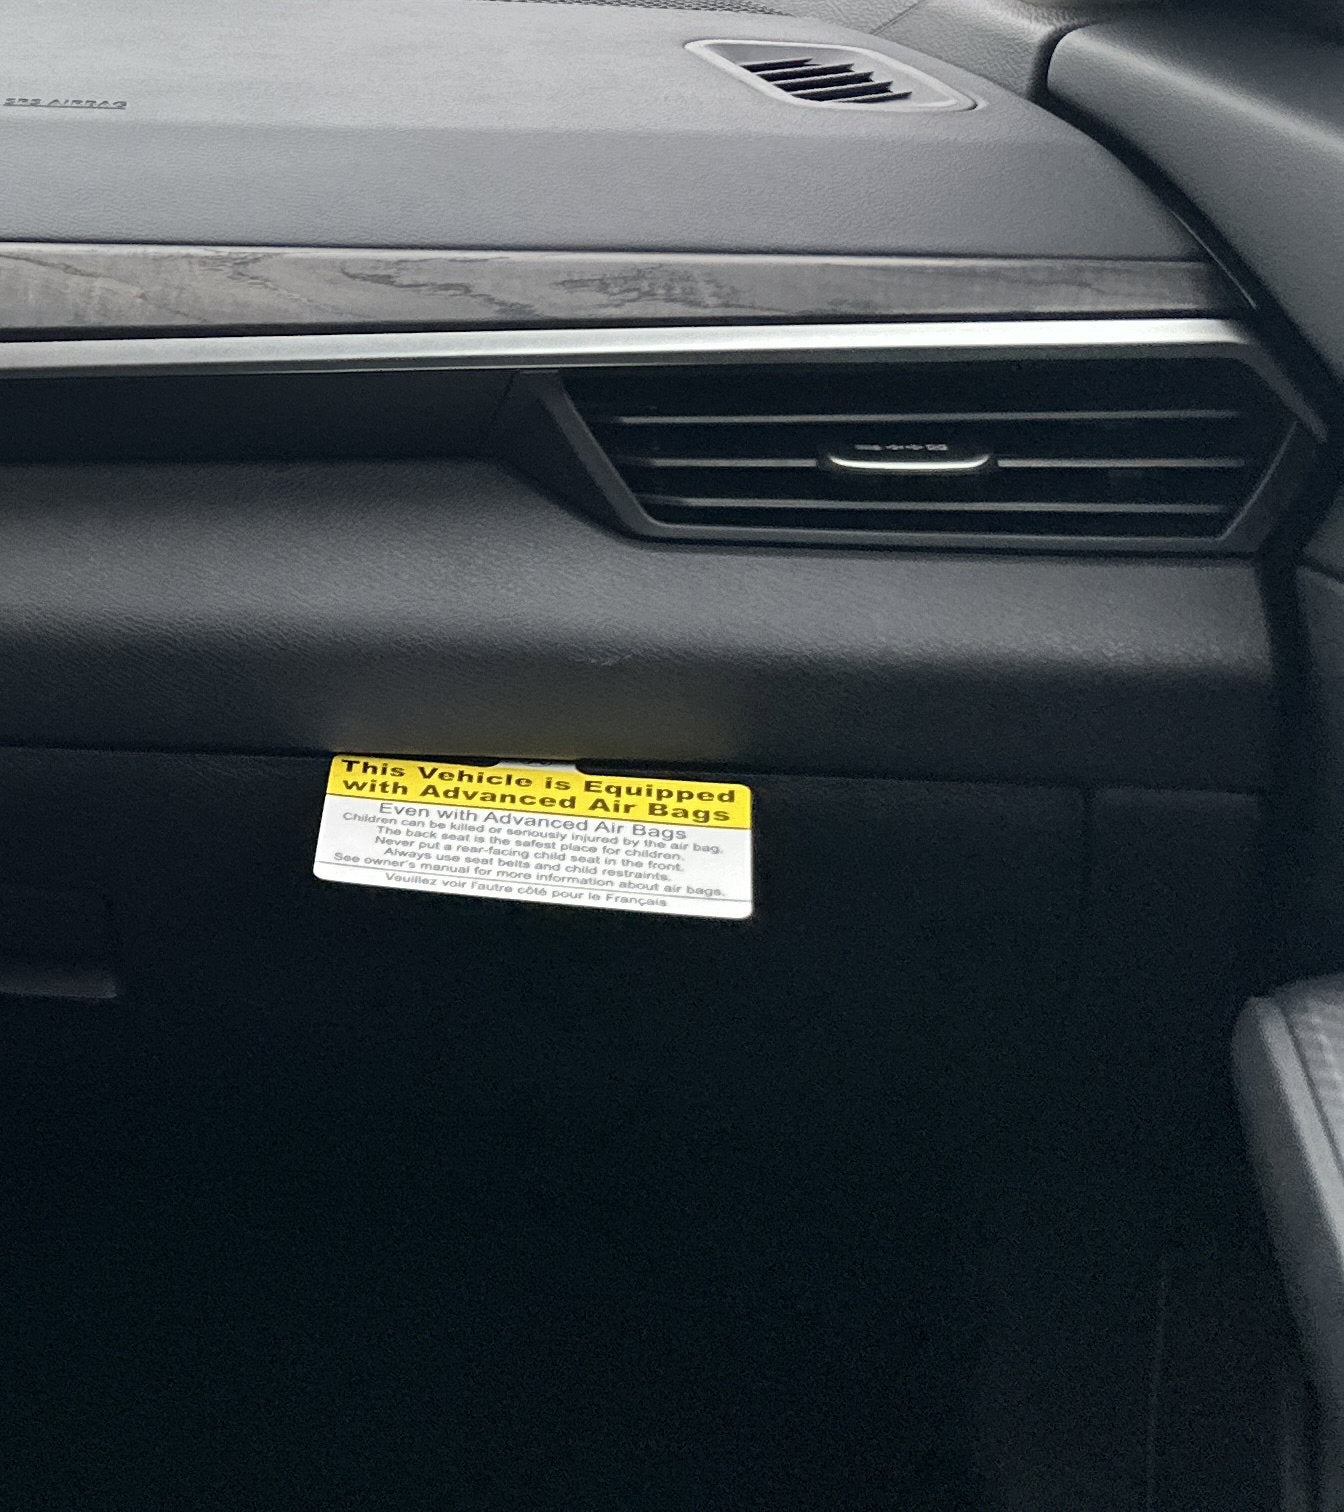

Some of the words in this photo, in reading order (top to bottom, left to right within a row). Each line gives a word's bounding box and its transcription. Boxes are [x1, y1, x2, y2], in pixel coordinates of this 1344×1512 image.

[341, 759, 406, 777] This
[417, 766, 533, 787] Vehicle
[545, 777, 571, 790] is
[584, 779, 735, 803] Equipped
[342, 779, 408, 795] with
[419, 784, 576, 809] Advanced
[588, 798, 638, 814] Air
[648, 803, 731, 823] Bags
[342, 811, 398, 825] Children
[401, 819, 425, 828] can
[429, 819, 447, 829] be
[450, 822, 485, 833] killed
[506, 828, 568, 842] seriously
[571, 832, 619, 844] injured
[622, 837, 640, 848] by
[643, 839, 667, 849] the
[670, 842, 689, 850] air
[377, 825, 402, 836] The
[405, 828, 438, 840] back
[441, 832, 470, 842] seat
[474, 834, 485, 843] is
[489, 836, 511, 846] the
[514, 839, 556, 850] safest
[560, 842, 598, 853] place
[602, 845, 621, 855] for
[379, 802, 430, 818] Even
[437, 807, 478, 822] with
[483, 811, 589, 831] Advanced
[594, 820, 625, 834] Air
[631, 823, 687, 842] Bags
[374, 835, 415, 848] Never
[418, 840, 442, 851] put
[456, 845, 530, 860] rear-facing
[534, 851, 566, 862] child
[570, 855, 601, 865] seat
[604, 857, 617, 866] in
[621, 858, 644, 868] the
[383, 847, 433, 861] Always
[436, 854, 461, 862] use
[464, 855, 493, 866] seat
[497, 858, 530, 869] belts
[534, 862, 562, 872] and
[564, 864, 598, 875] child
[333, 852, 361, 863] See
[420, 863, 470, 874] manual
[473, 866, 493, 875] for
[496, 869, 532, 880] more
[536, 872, 614, 886] information
[618, 880, 660, 891] about
[663, 884, 683, 893] air
[385, 872, 438, 886] Veuillez
[442, 878, 467, 888] voir
[551, 890, 585, 900] pour
[588, 892, 601, 901] le
[605, 893, 668, 907] Français
